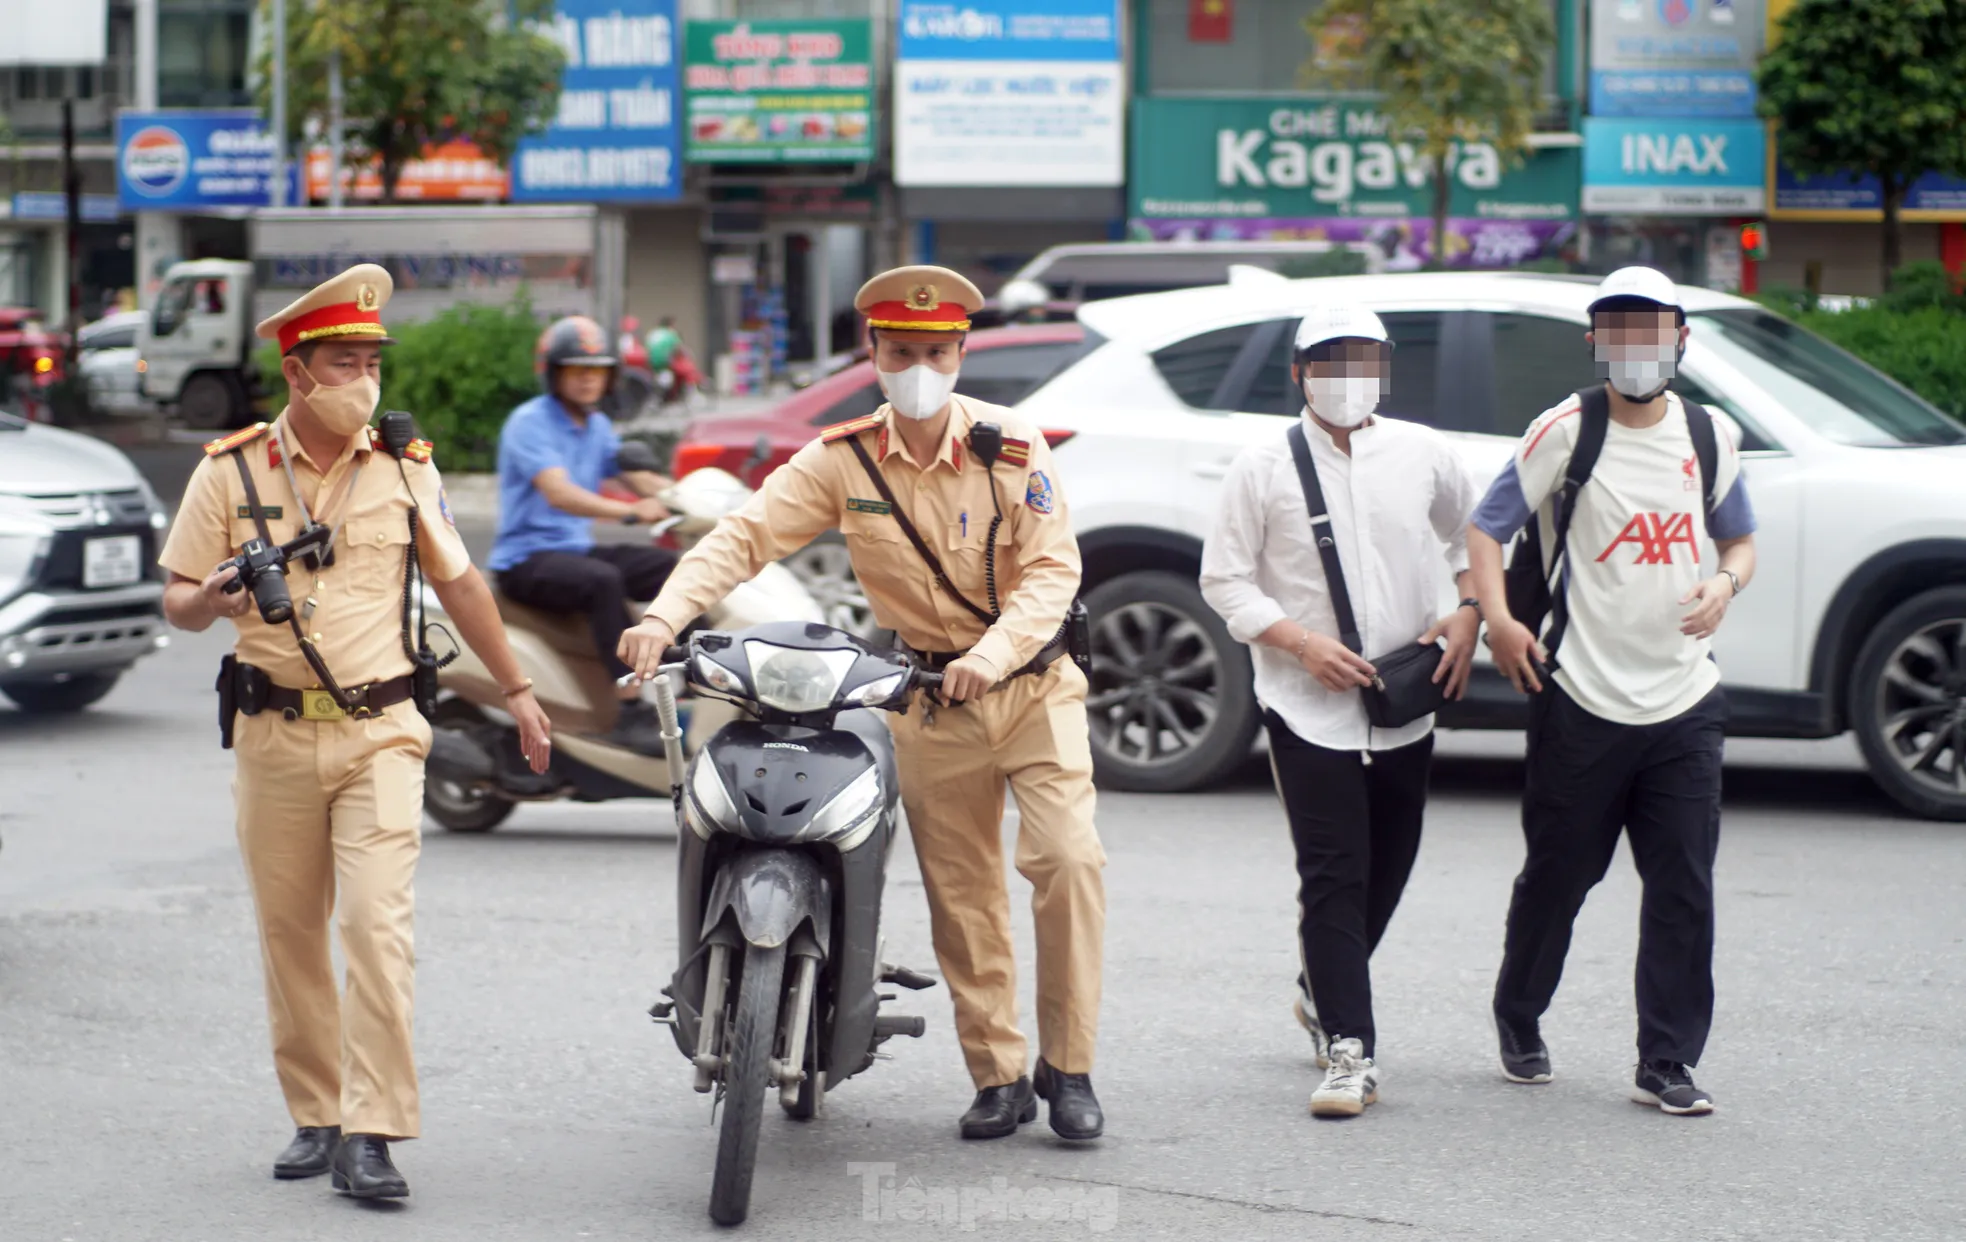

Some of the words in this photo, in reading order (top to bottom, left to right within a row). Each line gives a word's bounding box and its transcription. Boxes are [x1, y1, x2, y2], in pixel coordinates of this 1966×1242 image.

[1621, 133, 1728, 175] INAX
[1595, 512, 1700, 565] AXA
[762, 742, 809, 753] HONDA
